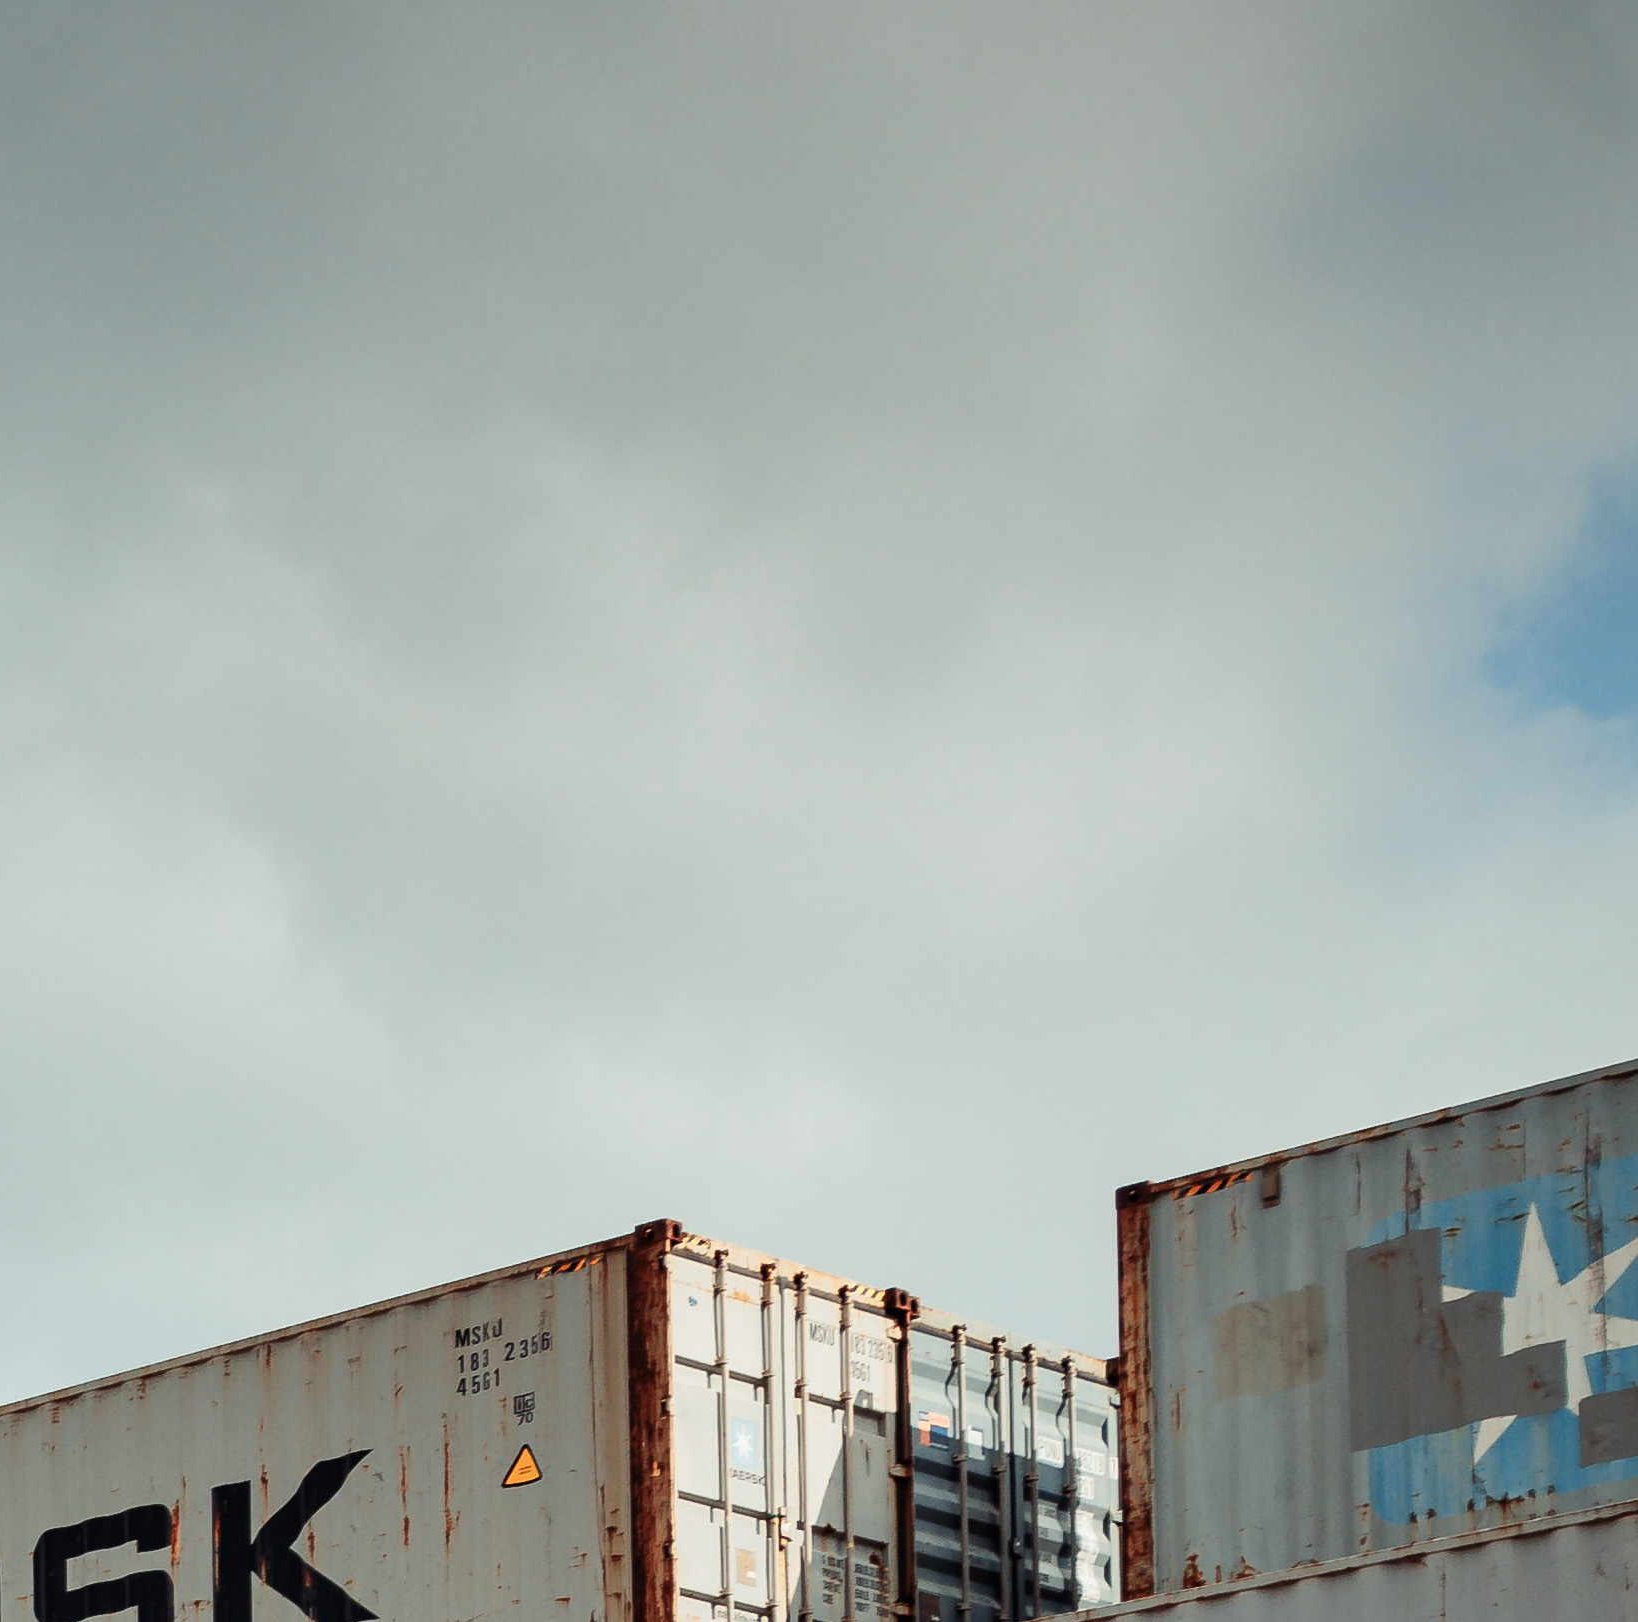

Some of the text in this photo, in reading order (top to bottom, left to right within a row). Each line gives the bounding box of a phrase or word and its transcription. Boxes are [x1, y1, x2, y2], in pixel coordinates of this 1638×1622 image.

[455, 1318, 504, 1348] MSKU
[458, 1348, 490, 1374] 183
[456, 1368, 501, 1397] 45G1
